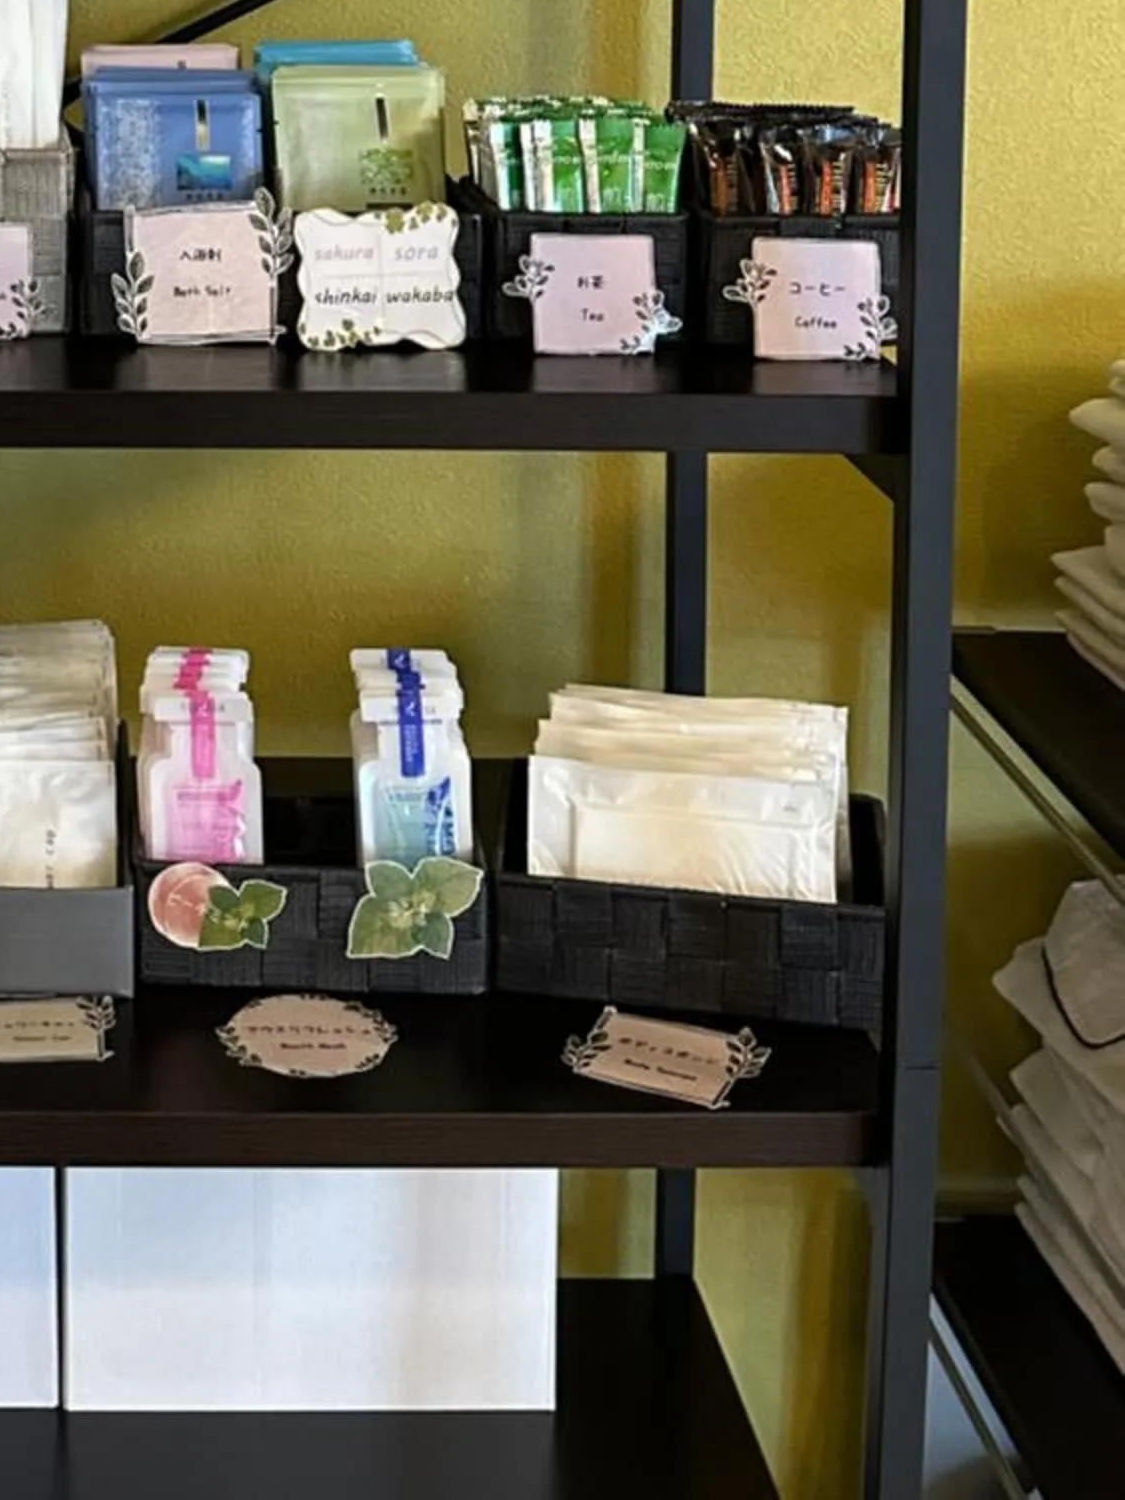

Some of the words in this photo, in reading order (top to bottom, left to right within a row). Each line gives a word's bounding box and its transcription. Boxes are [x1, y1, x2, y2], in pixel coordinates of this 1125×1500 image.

[315, 244, 374, 261] sakura
[394, 246, 439, 261] sora
[386, 284, 457, 304] wakaba
[789, 281, 846, 297] コーヒー
[580, 307, 604, 322] Tea
[795, 315, 837, 330] Coffee
